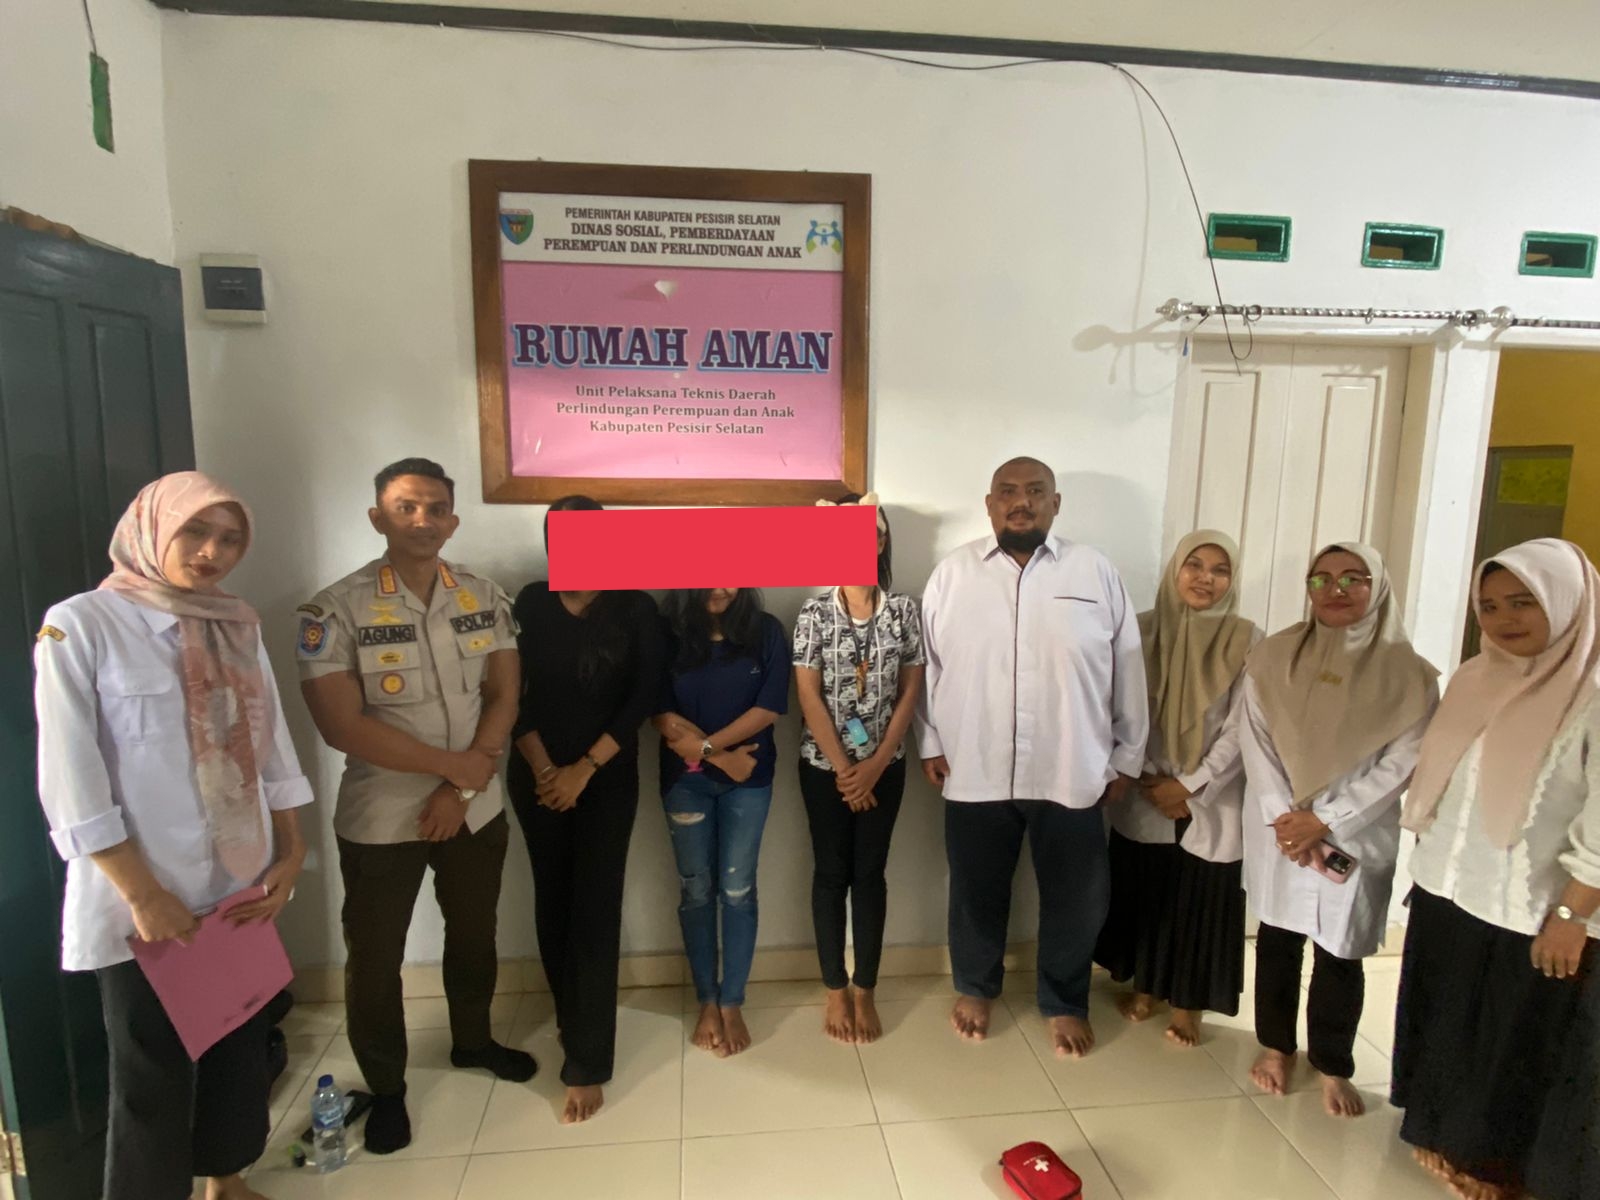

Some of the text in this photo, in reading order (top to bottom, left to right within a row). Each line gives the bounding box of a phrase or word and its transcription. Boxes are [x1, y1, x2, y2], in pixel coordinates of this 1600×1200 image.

[564, 207, 781, 226] PEMERINTAH KABUPATEN PESISIR SELATAN
[571, 222, 775, 241] DINAS SOSIAL, PEMBERDAYAAN
[543, 238, 802, 259] PEREMPUAN DAN PERLINDUNGAN ANAK
[512, 323, 834, 373] RUMAH AMAN
[576, 385, 776, 400] Unit Pelaksana Teknis Daerah
[557, 402, 795, 418] Perlindungan Perempuan dan Anak
[590, 420, 764, 435] Kabupaten Pesisir Selatan
[362, 627, 412, 645] AGUNG
